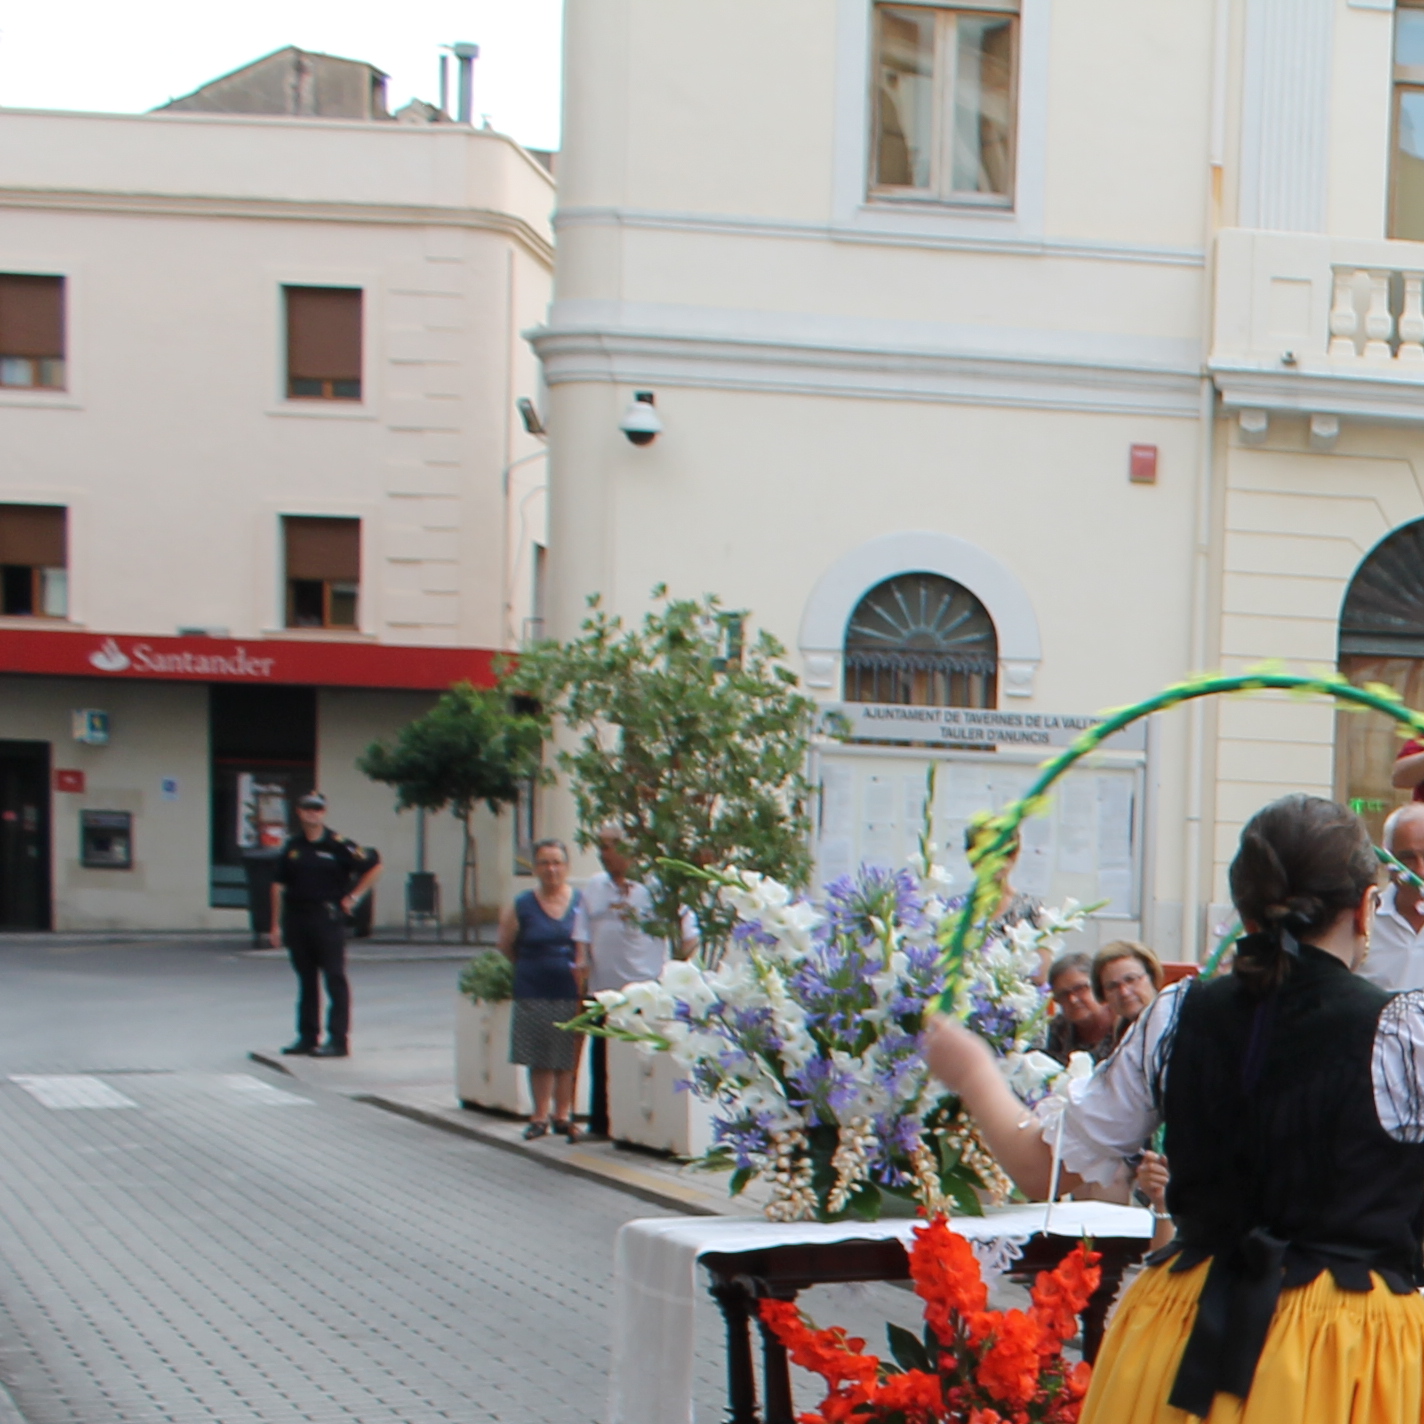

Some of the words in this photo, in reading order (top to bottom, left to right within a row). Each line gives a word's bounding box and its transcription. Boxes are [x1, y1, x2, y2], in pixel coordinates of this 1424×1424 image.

[132, 643, 275, 677] Santander
[862, 707, 940, 721] AJUNTAMENT
[944, 711, 959, 722] DE
[962, 712, 1022, 726] TAVERNES
[1025, 715, 1040, 727] DE
[1044, 717, 1058, 728] LA
[940, 726, 983, 740] TAULER
[986, 730, 1049, 744] D'ANUNCIS
